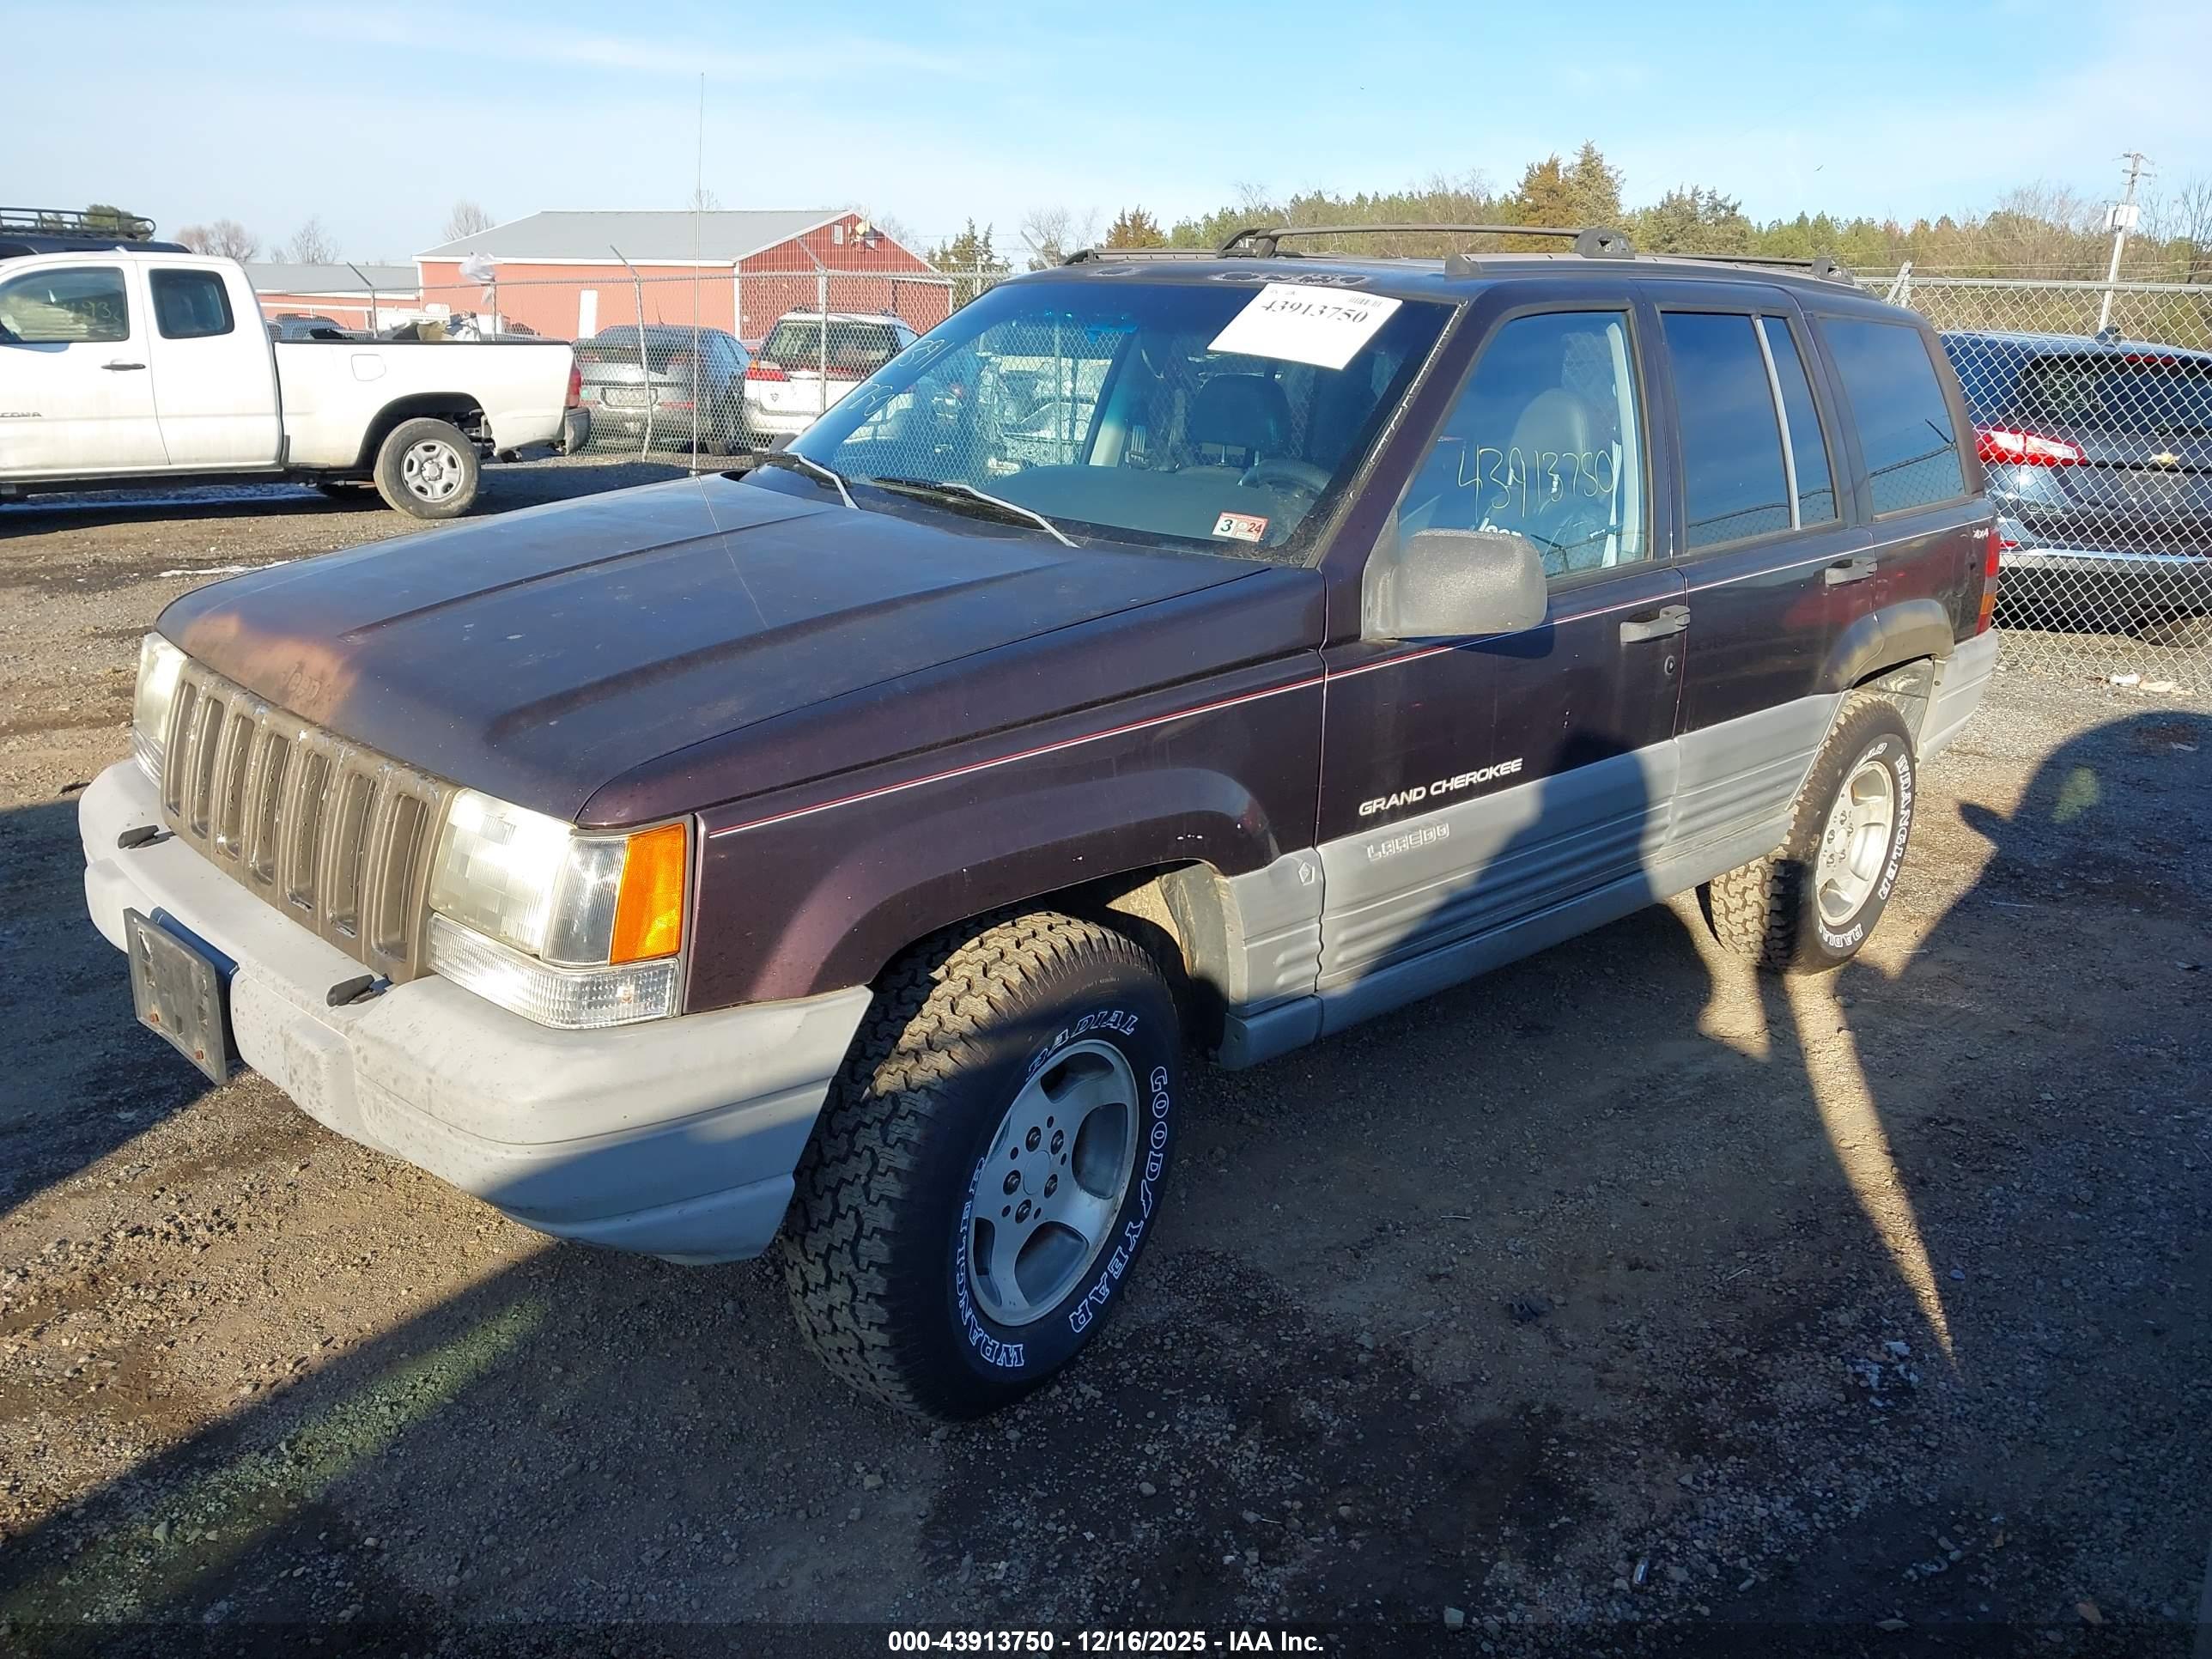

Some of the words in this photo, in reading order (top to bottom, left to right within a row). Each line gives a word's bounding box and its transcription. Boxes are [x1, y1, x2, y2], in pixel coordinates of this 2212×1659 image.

[1261, 300, 1369, 323] 43913750
[1458, 444, 1614, 522] 43913750
[1220, 519, 1233, 532] 3
[1247, 522, 1262, 534] 24
[1358, 786, 1426, 817] GRAND
[1430, 757, 1523, 796] CHEROKEE
[1877, 754, 1912, 900] WRANGLER
[1069, 1066, 1169, 1334] GOODYEAR
[956, 1157, 1025, 1367] WRANGLER
